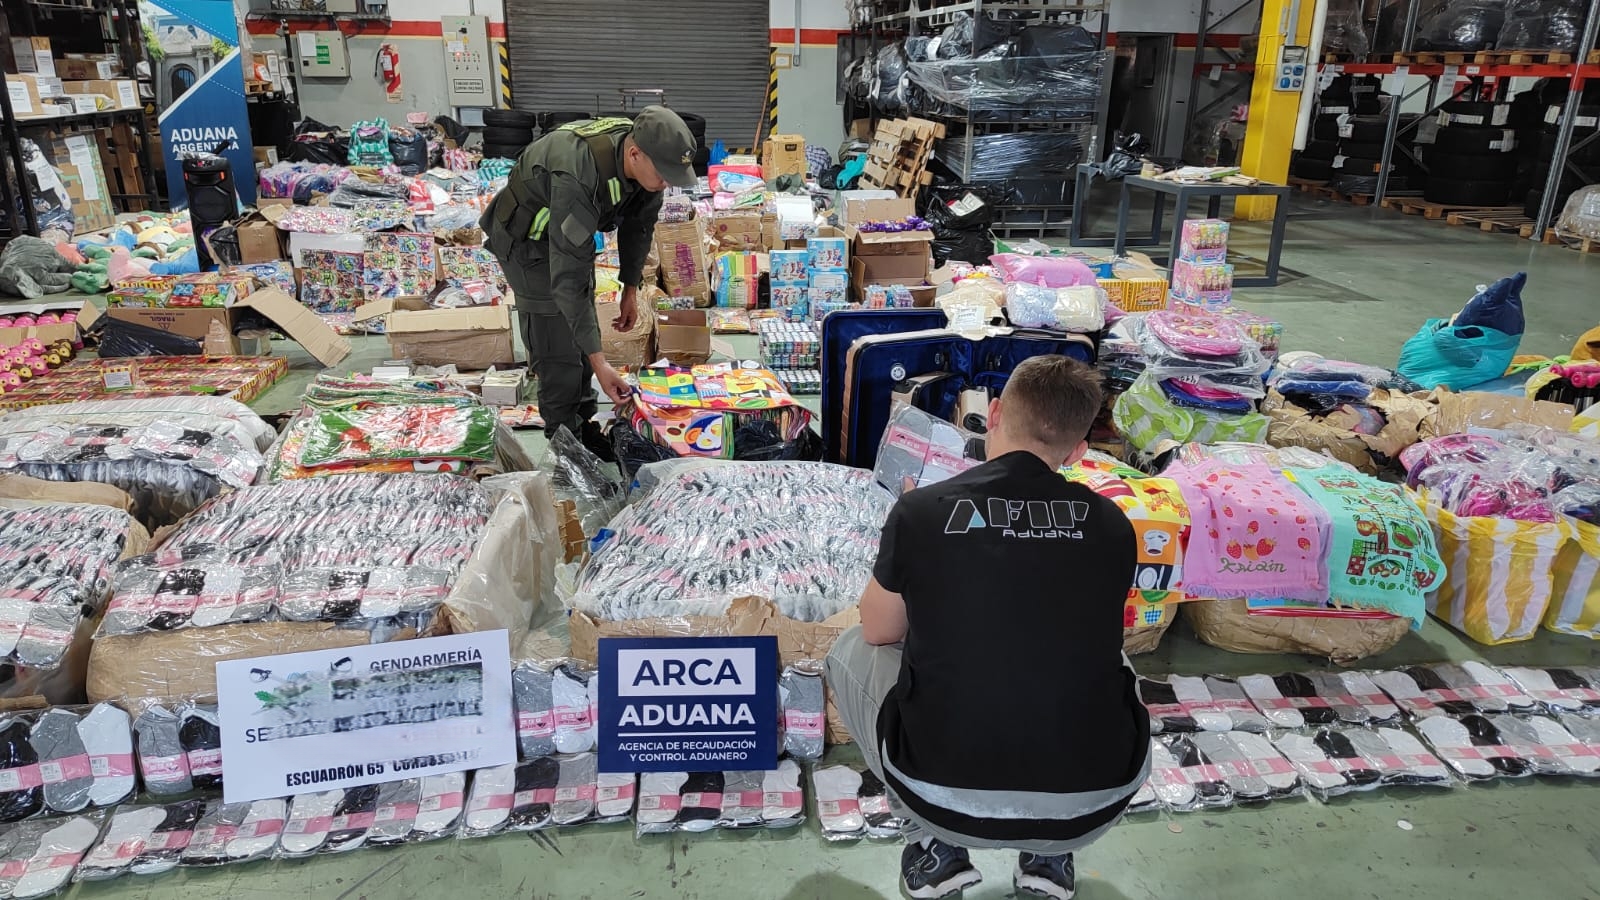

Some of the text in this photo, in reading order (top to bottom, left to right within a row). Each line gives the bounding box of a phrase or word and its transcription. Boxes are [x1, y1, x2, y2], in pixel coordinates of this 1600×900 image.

[171, 127, 238, 142] ADUANA
[172, 141, 239, 153] ARGENTA
[945, 498, 1089, 534] AFIP
[632, 659, 742, 686] ARCA
[618, 703, 756, 727] ADUANA
[618, 739, 756, 751] AGENCIA DE RECAUDACIÓN
[630, 752, 748, 762] Y CONTROL ADUANERO
[286, 762, 385, 787] ESCUADRÓN 65
